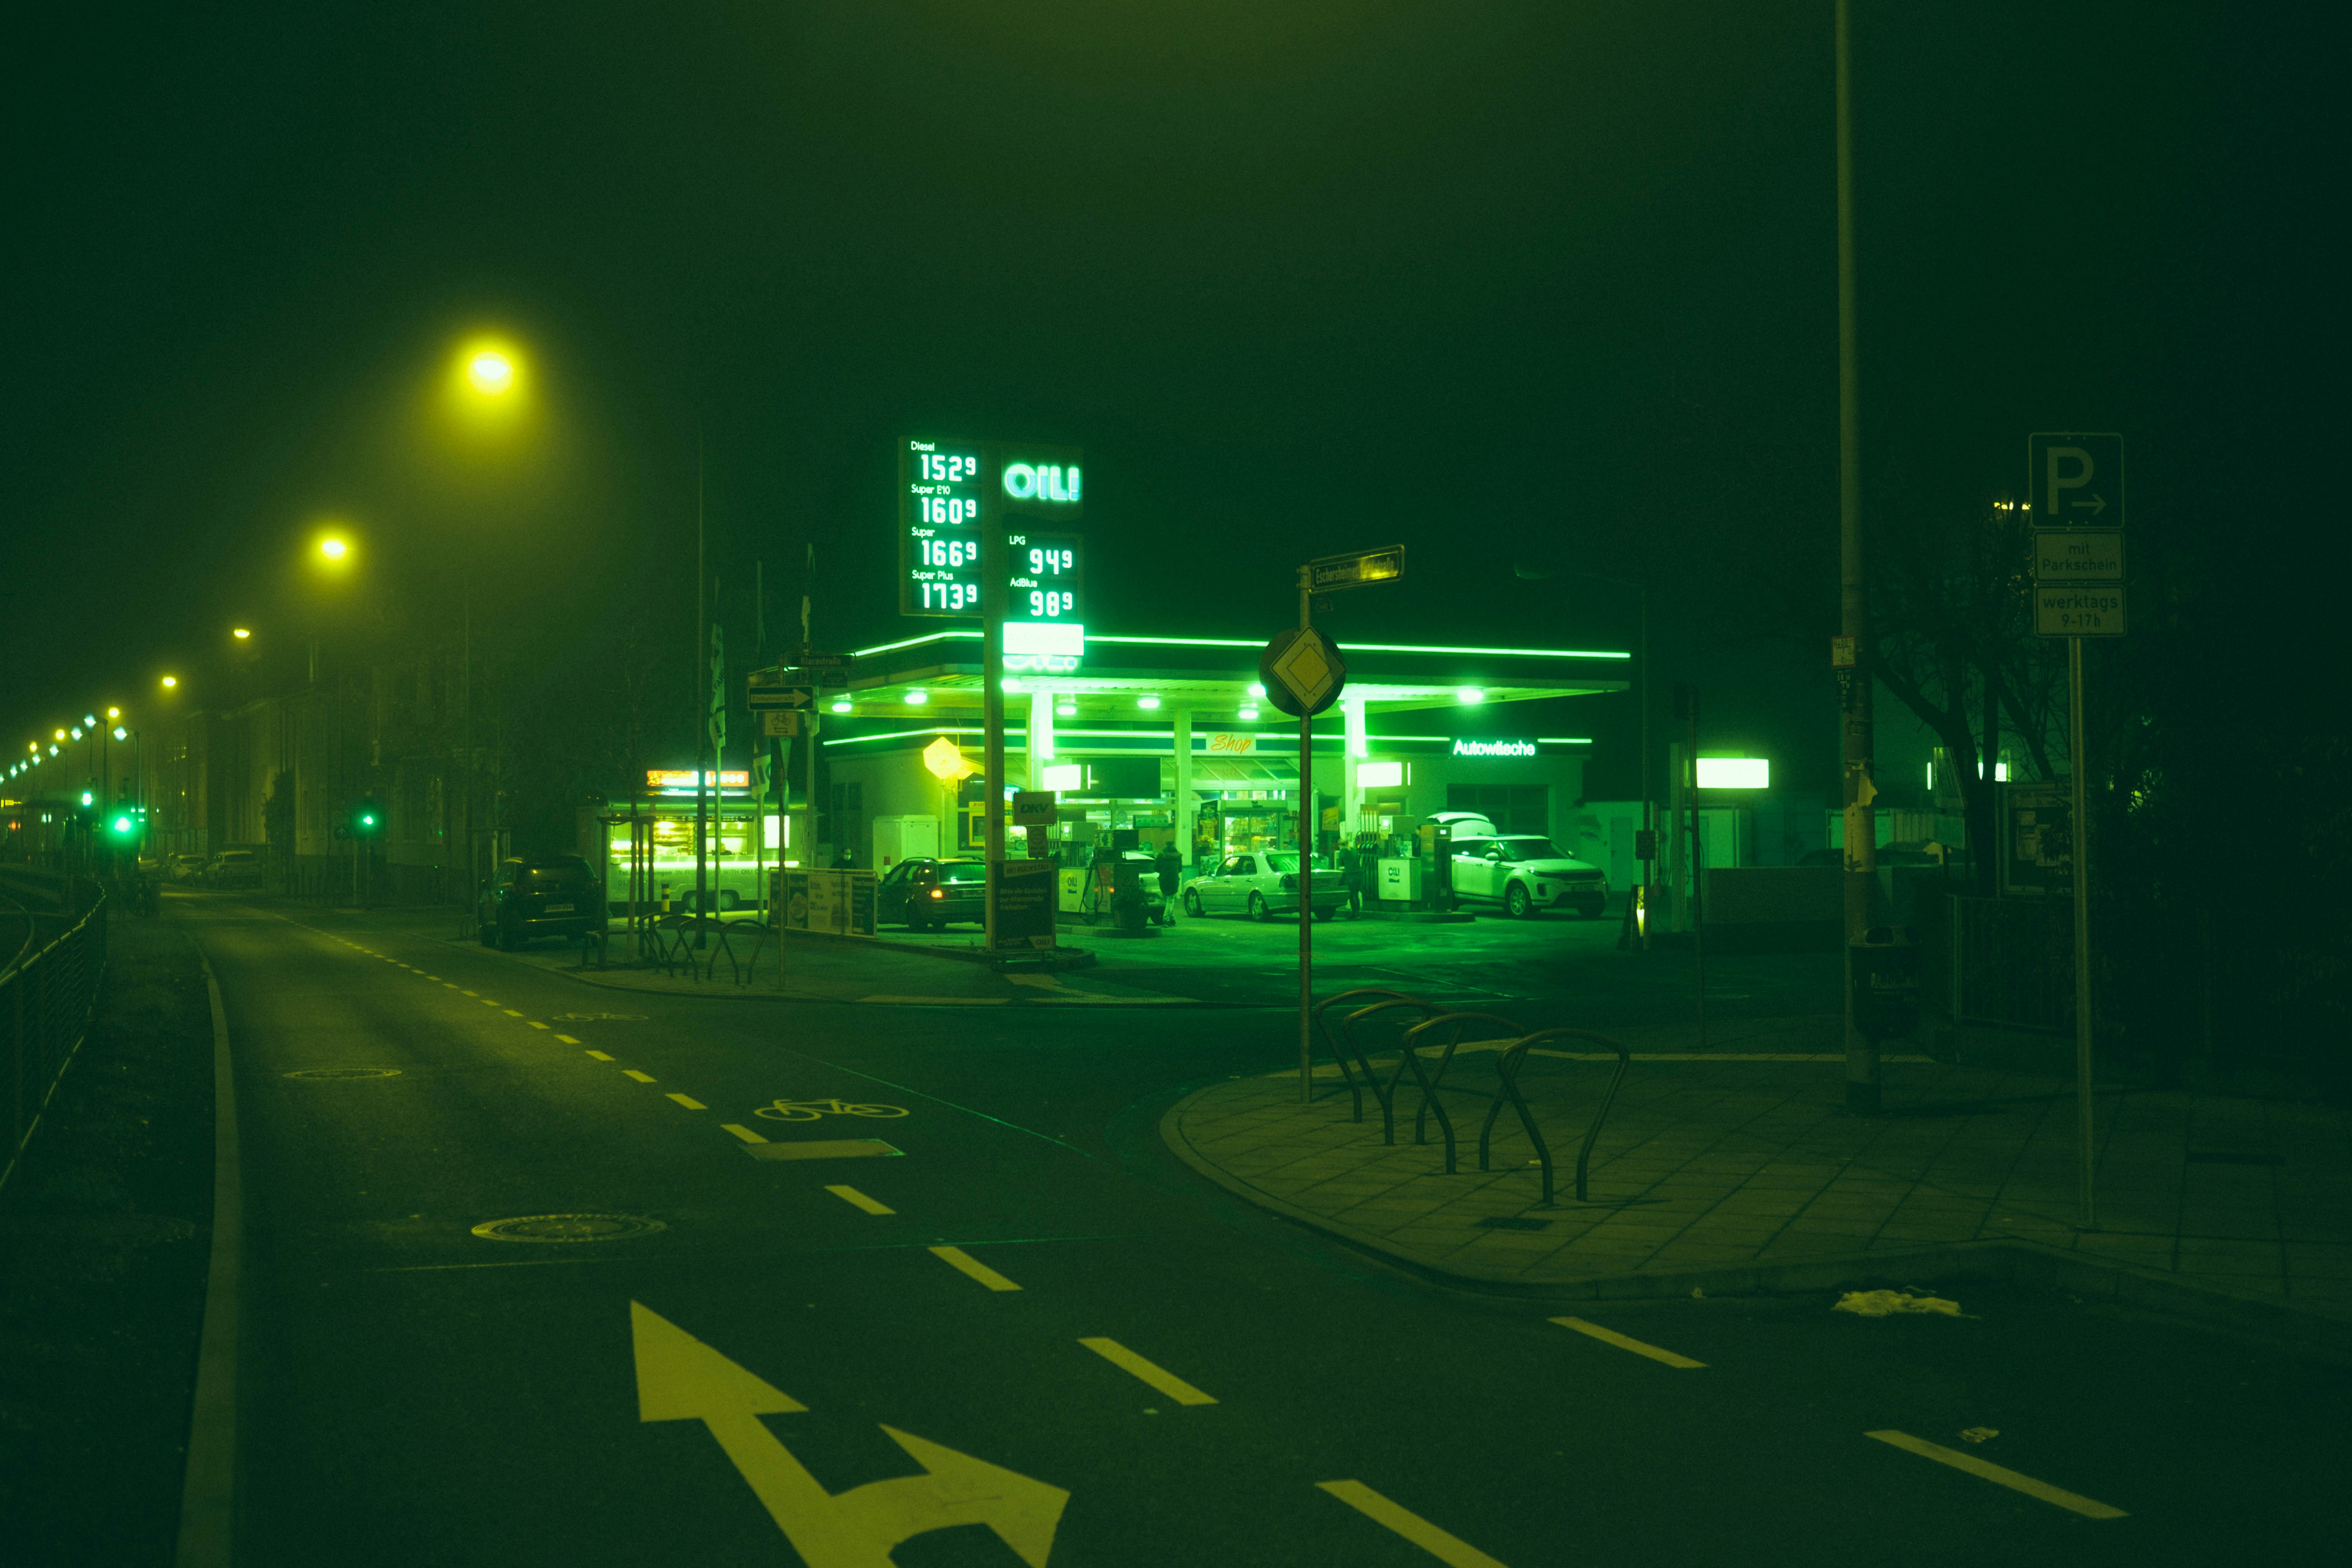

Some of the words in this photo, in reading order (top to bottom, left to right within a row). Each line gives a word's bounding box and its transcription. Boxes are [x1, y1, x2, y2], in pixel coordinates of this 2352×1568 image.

[911, 441, 935, 451] Diesel
[1004, 463, 1080, 501] OIL!
[2047, 446, 2094, 515] P
[911, 484, 935, 496] Super
[937, 485, 950, 495] E10
[911, 527, 935, 538] Super
[1009, 536, 1025, 545] LPG
[2069, 544, 2090, 555] mit
[2043, 559, 2117, 571] Parkschein
[912, 570, 935, 581] Super
[937, 571, 953, 581] Plus
[1316, 564, 1359, 584] Eschersheimer
[1010, 577, 1038, 588] AdBlue
[2043, 595, 2118, 612] werktags
[801, 656, 842, 665] Klarastraße
[1211, 734, 1252, 755] Shop
[1453, 739, 1535, 756] Autowäsche
[1020, 804, 1049, 813] DKV
[1067, 877, 1077, 887] OIL!
